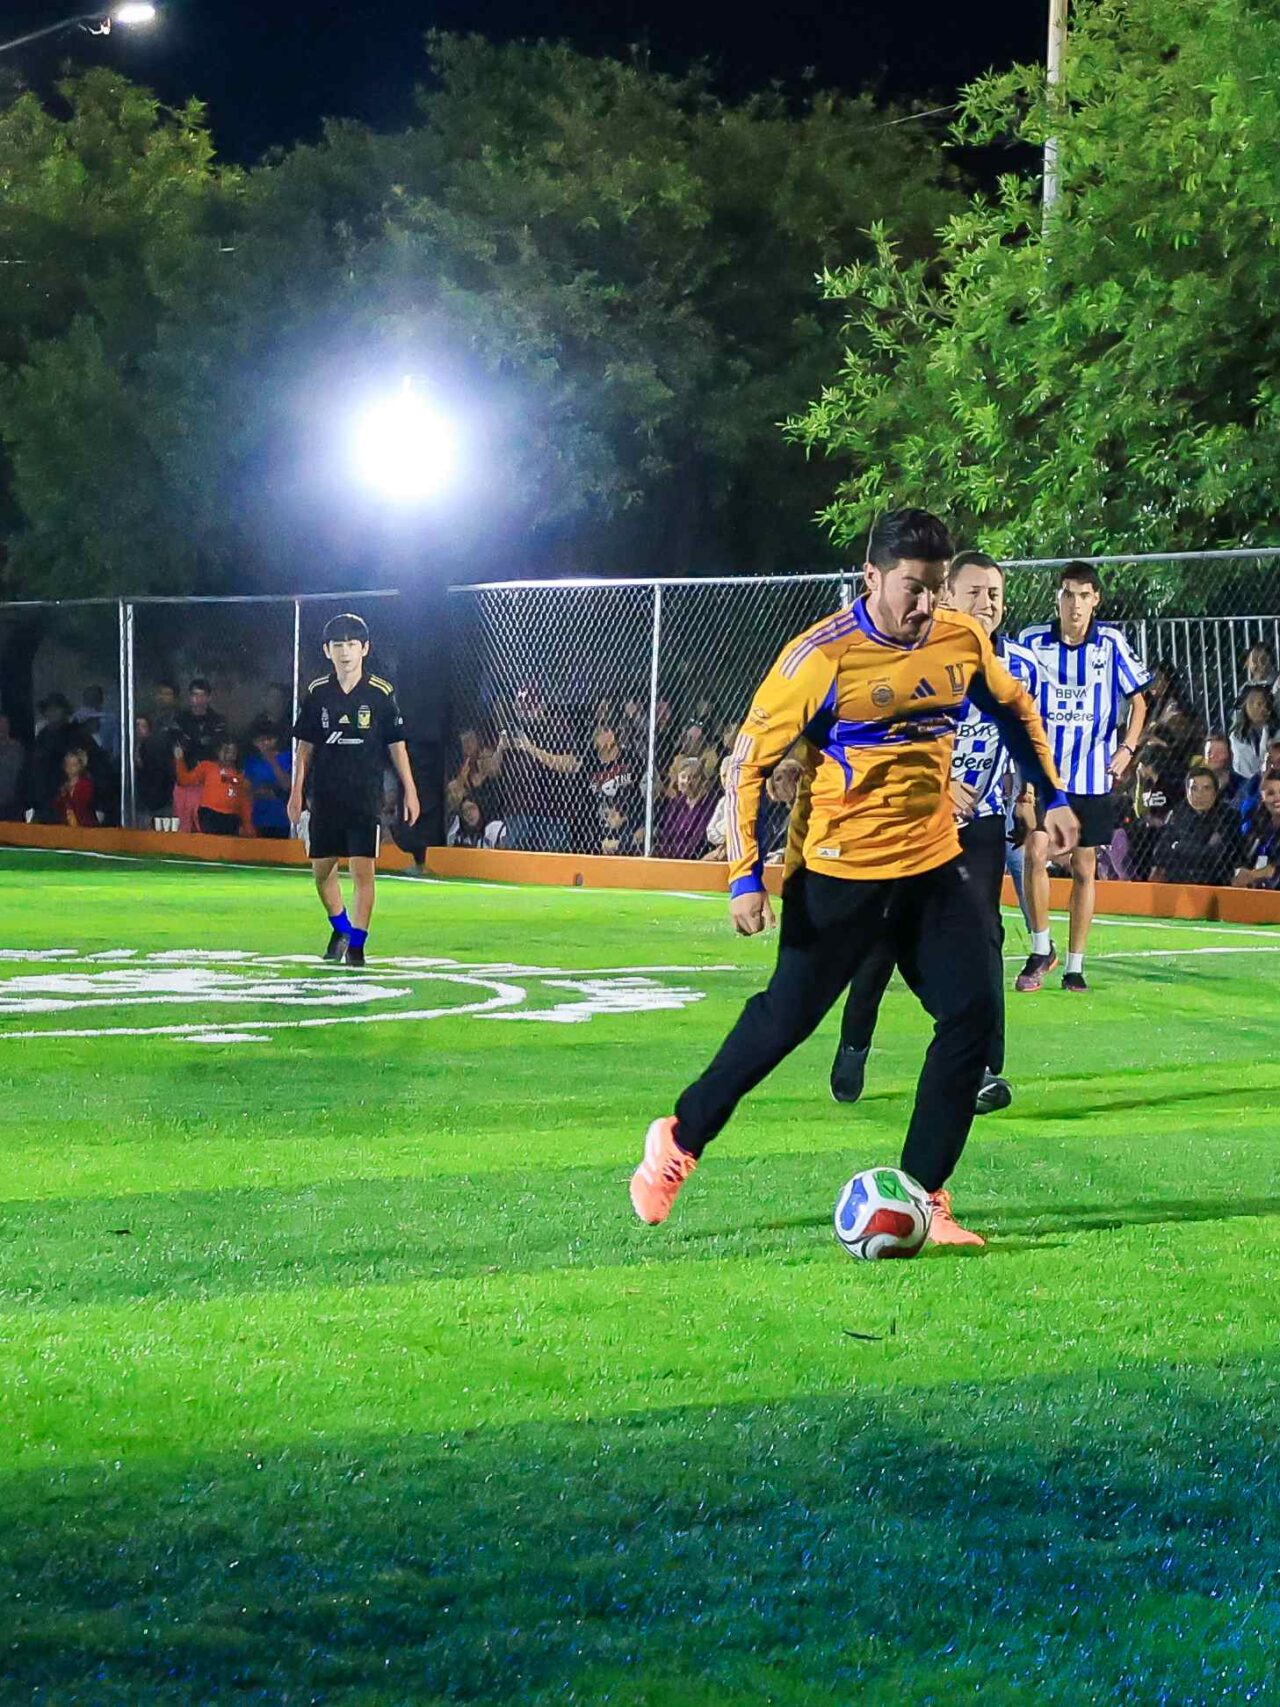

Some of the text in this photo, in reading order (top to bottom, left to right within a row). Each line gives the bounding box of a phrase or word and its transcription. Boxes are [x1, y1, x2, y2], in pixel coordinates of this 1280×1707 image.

[1055, 688, 1087, 699] BBVA
[1047, 709, 1094, 721] codere
[959, 722, 992, 737] BVA
[951, 753, 993, 770] dere
